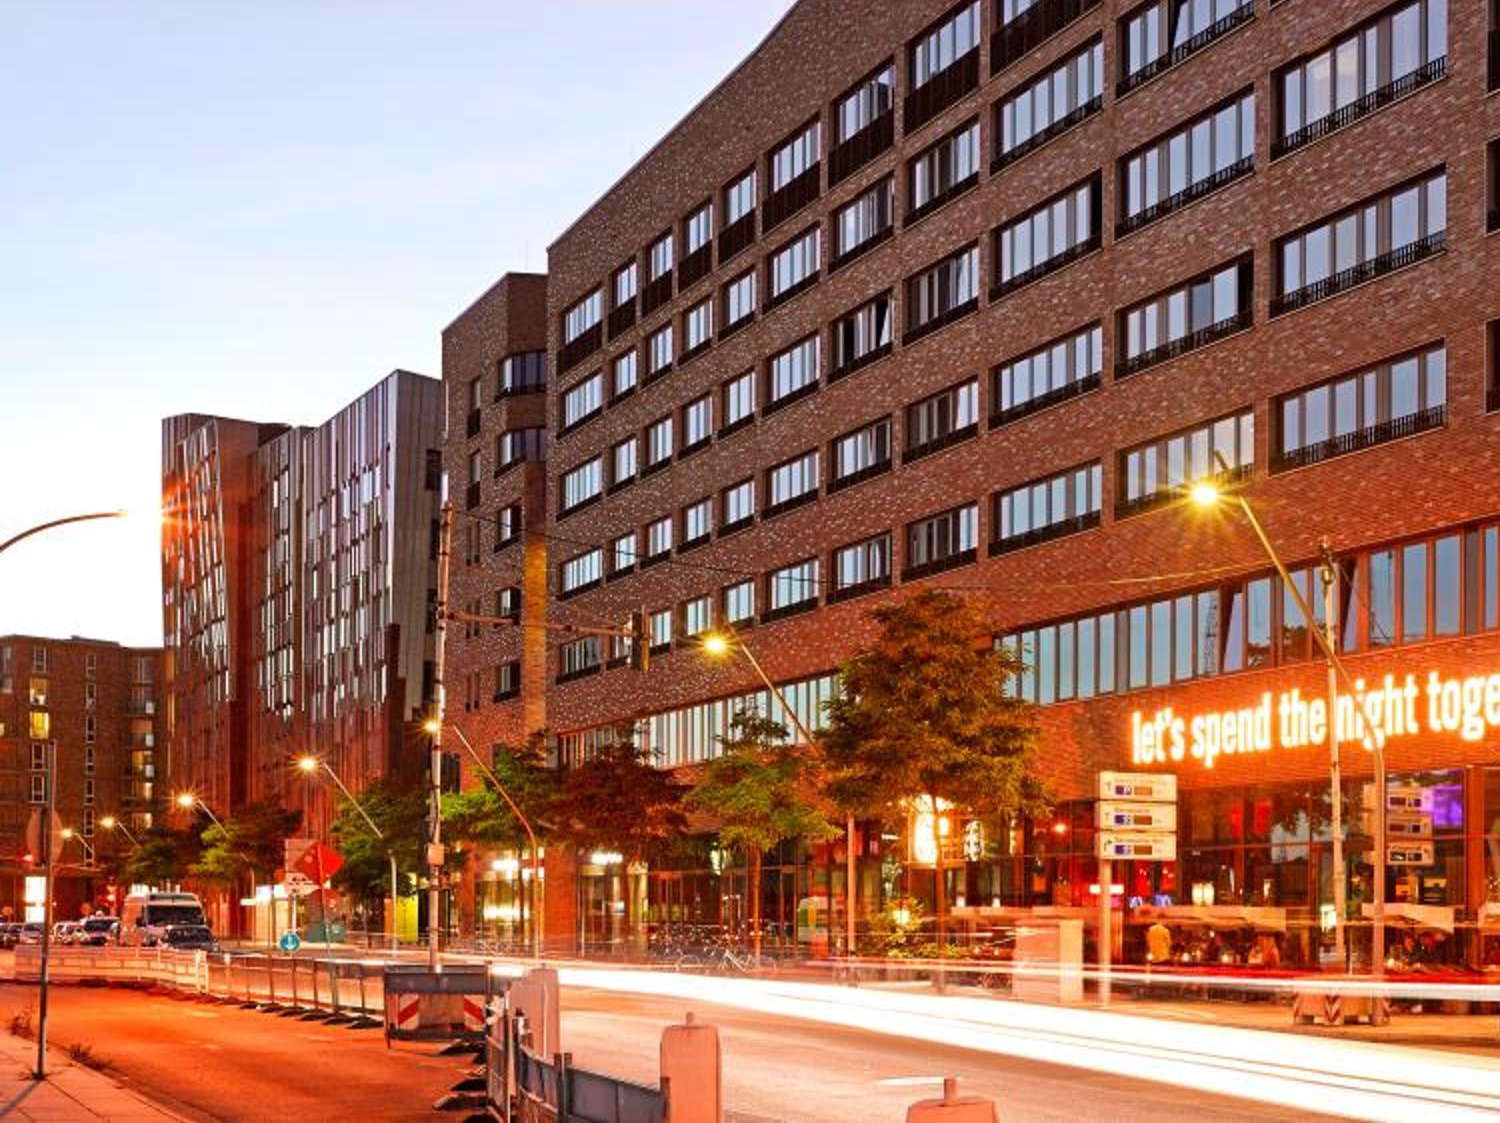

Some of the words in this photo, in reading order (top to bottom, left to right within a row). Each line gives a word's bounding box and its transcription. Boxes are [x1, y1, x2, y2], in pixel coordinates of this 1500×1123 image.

[1132, 705, 1186, 764] let's
[1191, 691, 1272, 768] spend
[1279, 688, 1327, 748] the
[1336, 673, 1419, 752] night
